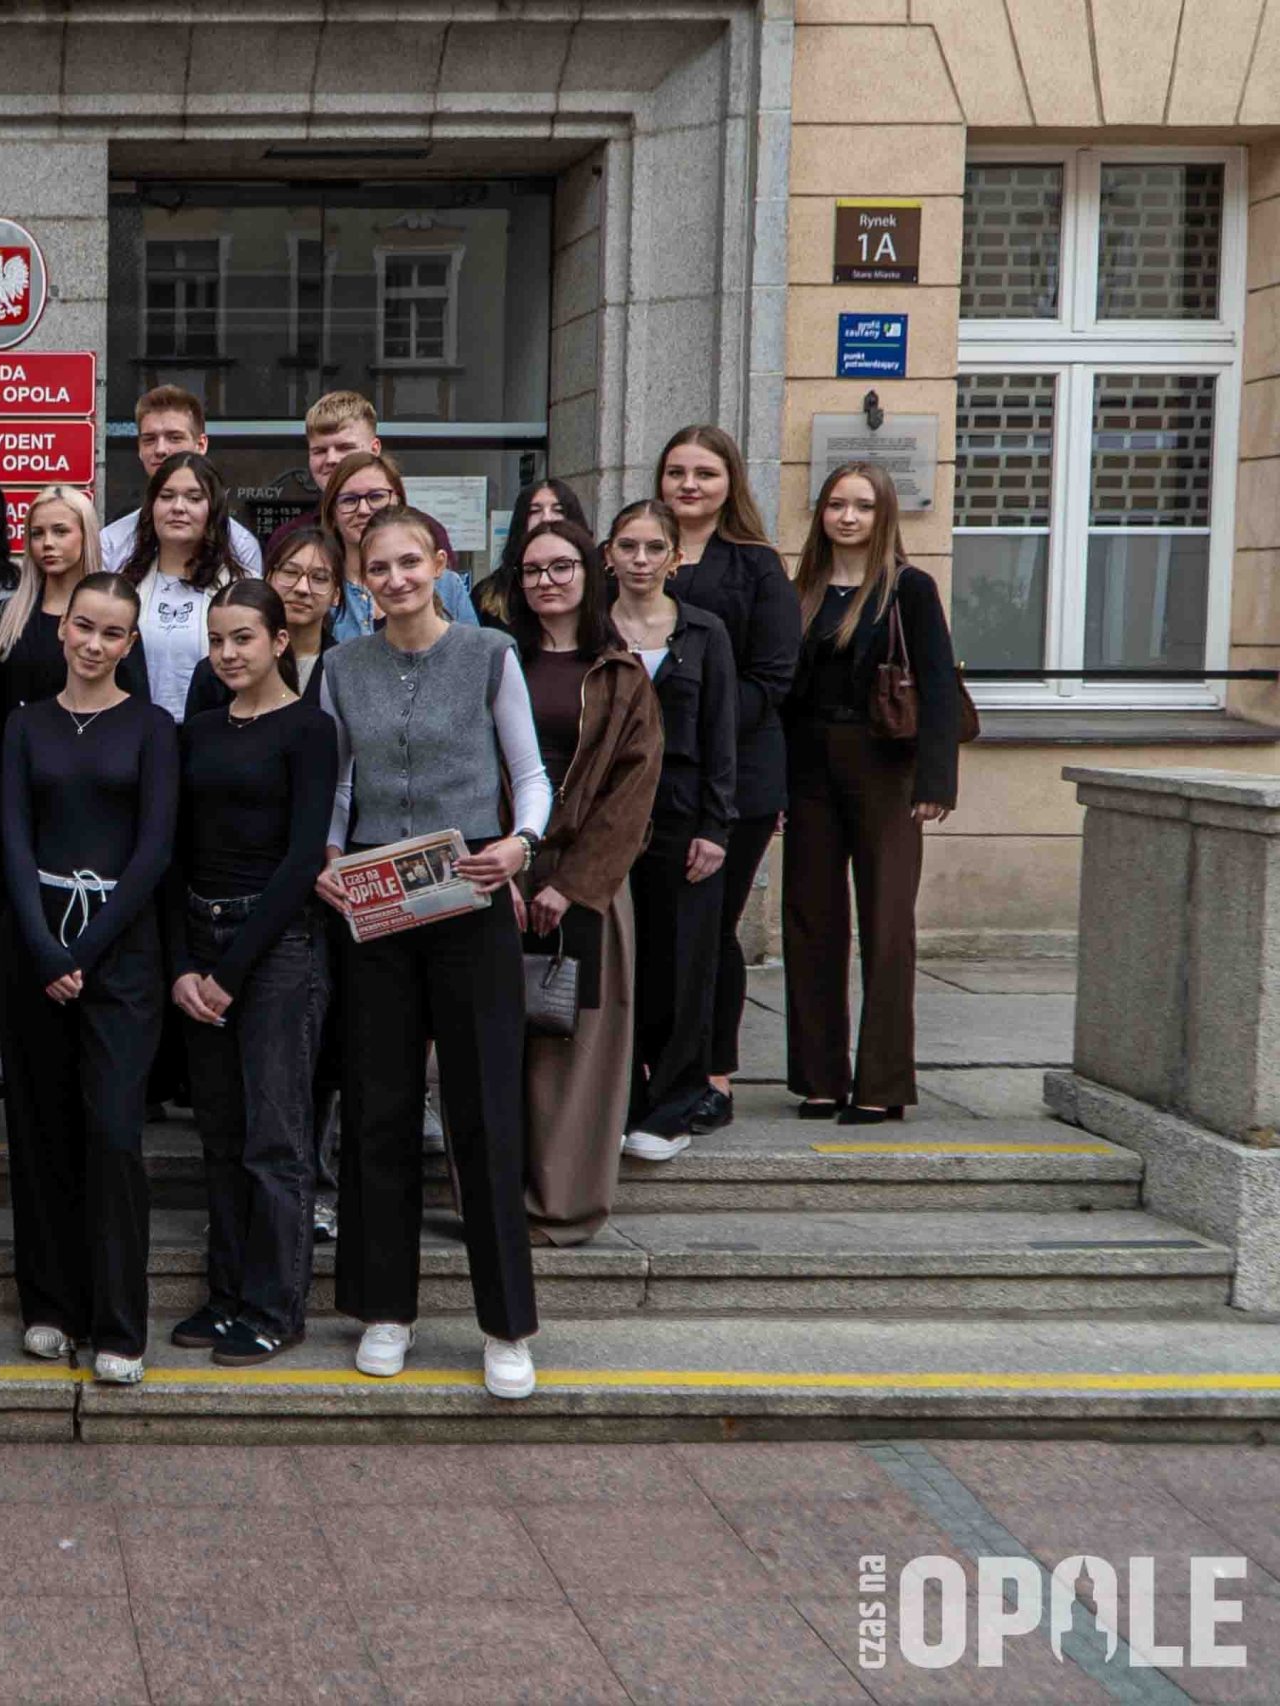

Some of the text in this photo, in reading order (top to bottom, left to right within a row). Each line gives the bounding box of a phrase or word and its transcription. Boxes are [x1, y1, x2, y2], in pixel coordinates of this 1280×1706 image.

[859, 213, 897, 229] Rynek
[857, 232, 897, 262] 1A
[3, 386, 70, 403] OPOLA
[3, 454, 70, 471] OPOLA
[237, 486, 284, 499] PRACY
[349, 877, 400, 904] OPOLE
